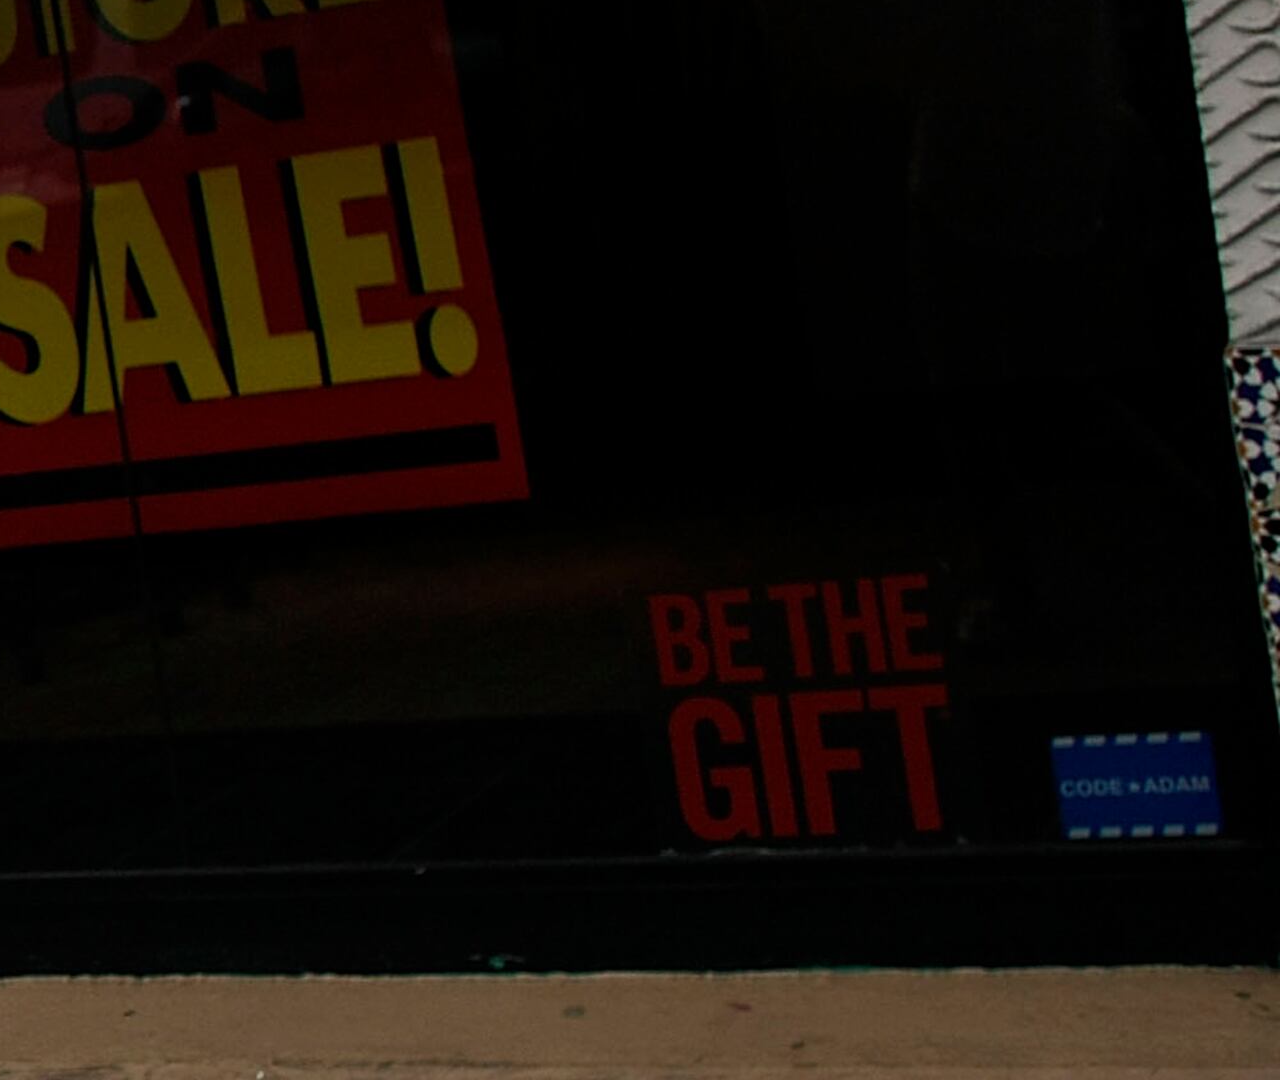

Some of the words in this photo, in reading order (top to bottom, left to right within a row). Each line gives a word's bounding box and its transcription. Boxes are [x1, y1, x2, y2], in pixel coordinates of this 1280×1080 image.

[45, 48, 304, 149] ON
[647, 586, 768, 688] BE
[767, 571, 945, 680] THE
[666, 683, 951, 843] GIFT
[1059, 777, 1124, 799] CODE
[1143, 775, 1212, 795] ADAM
